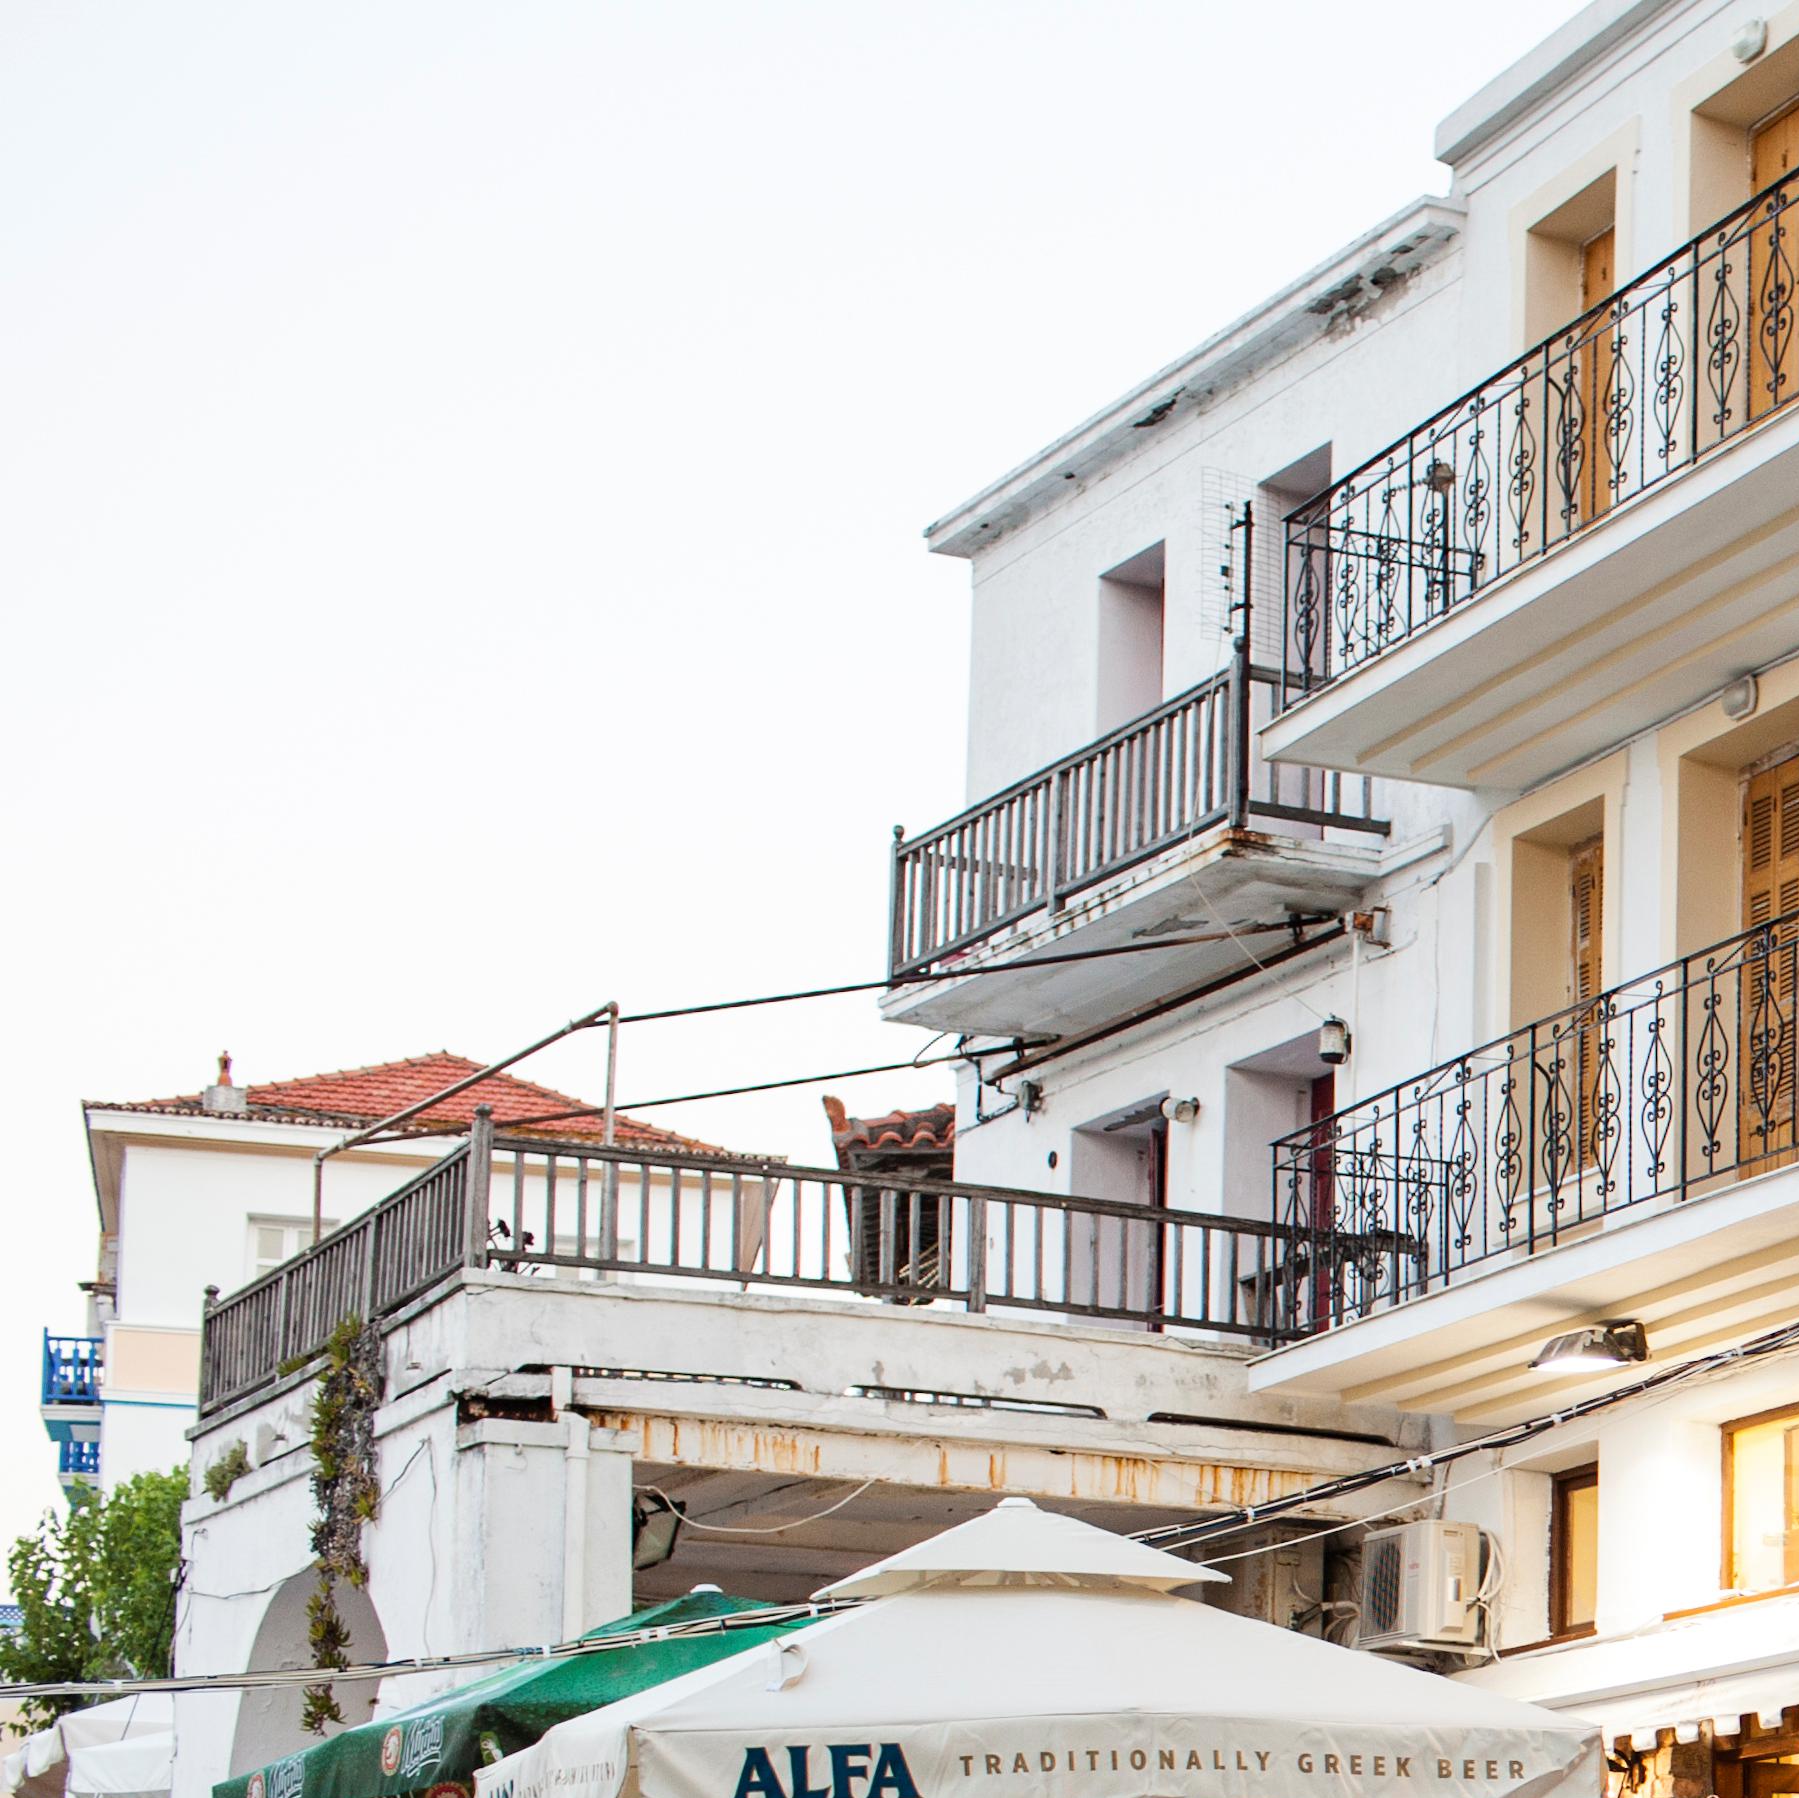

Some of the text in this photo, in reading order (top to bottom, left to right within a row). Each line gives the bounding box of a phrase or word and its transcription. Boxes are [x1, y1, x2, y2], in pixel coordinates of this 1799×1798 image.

[959, 1749, 1272, 1777] TRADITIONALLY
[1298, 1752, 1413, 1777] GREEK
[1437, 1759, 1526, 1780] BEER
